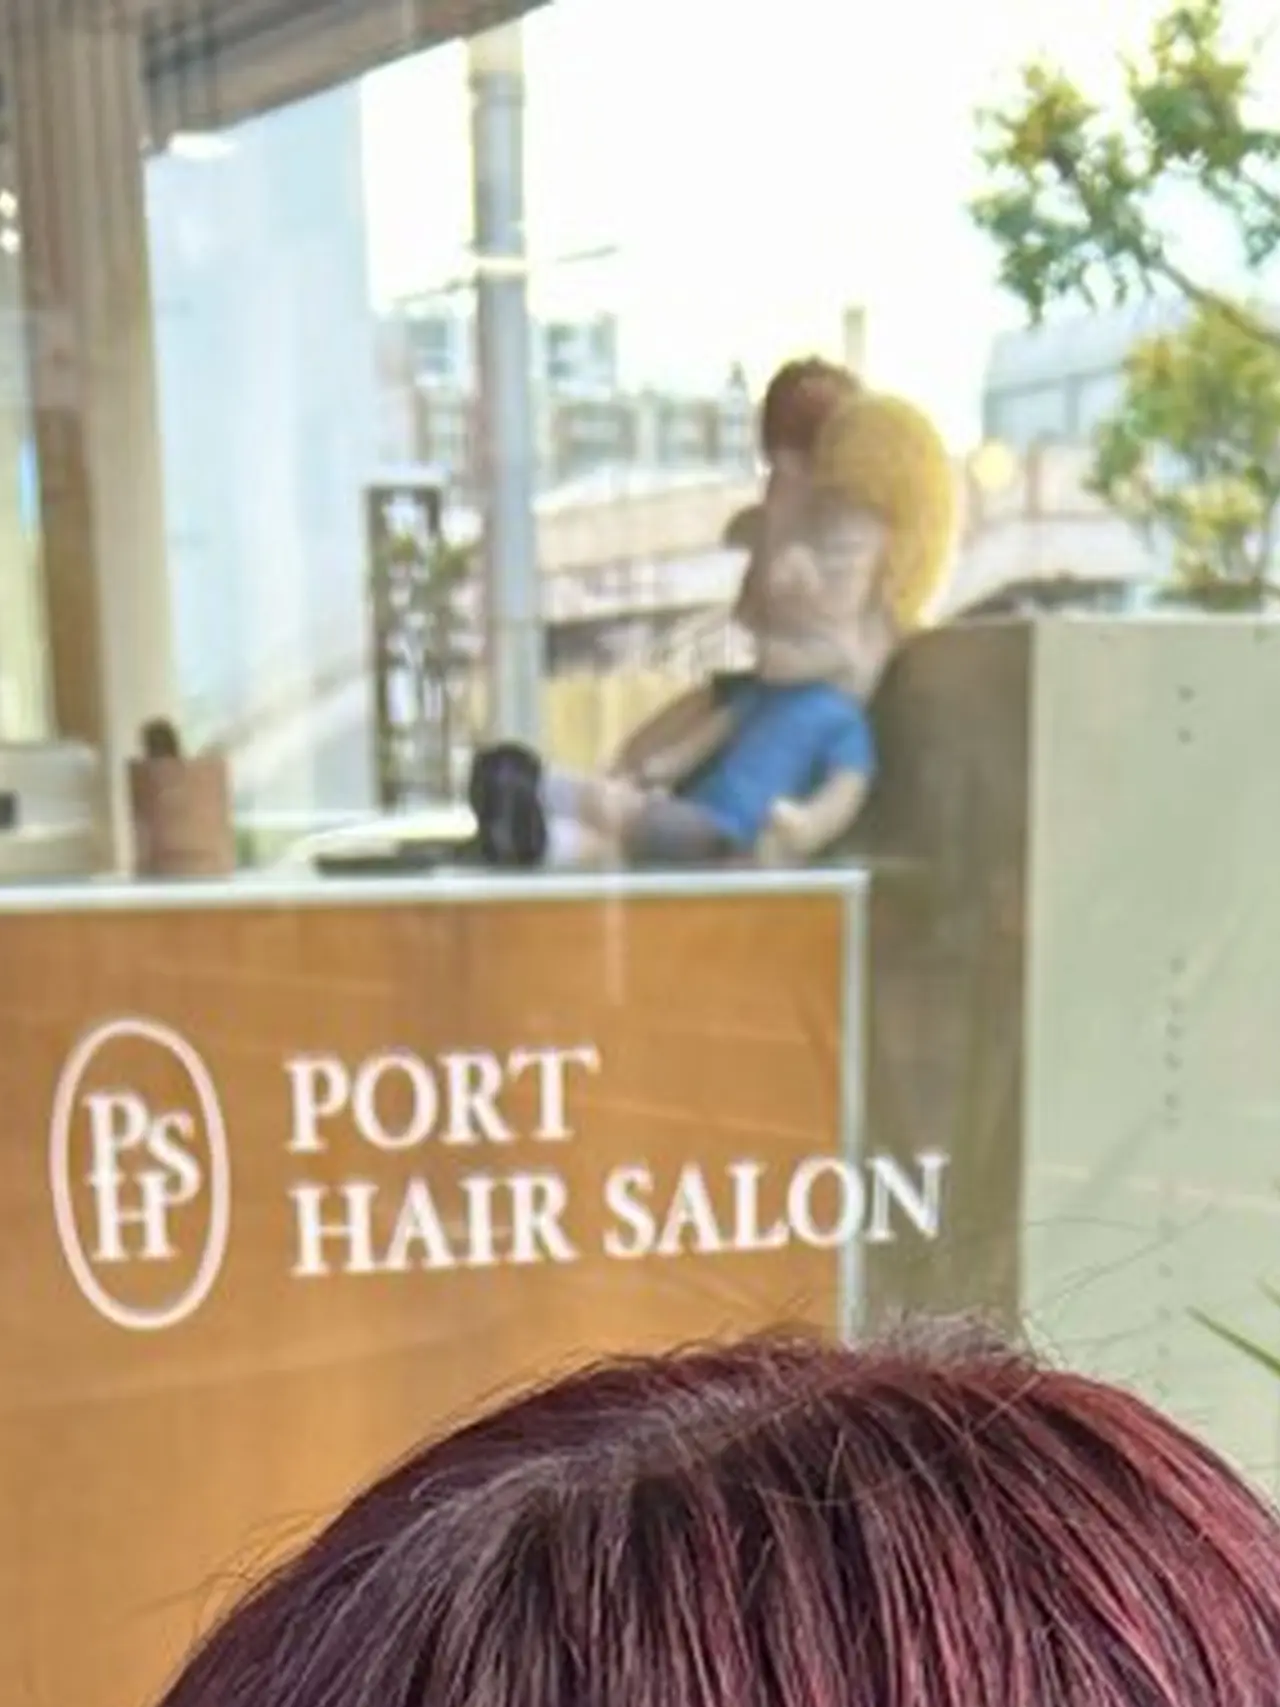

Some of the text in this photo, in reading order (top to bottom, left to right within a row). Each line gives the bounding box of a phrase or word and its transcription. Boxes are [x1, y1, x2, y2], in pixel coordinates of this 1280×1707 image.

[283, 1045, 600, 1151] PORT
[287, 1149, 949, 1275] HAIR SALON
